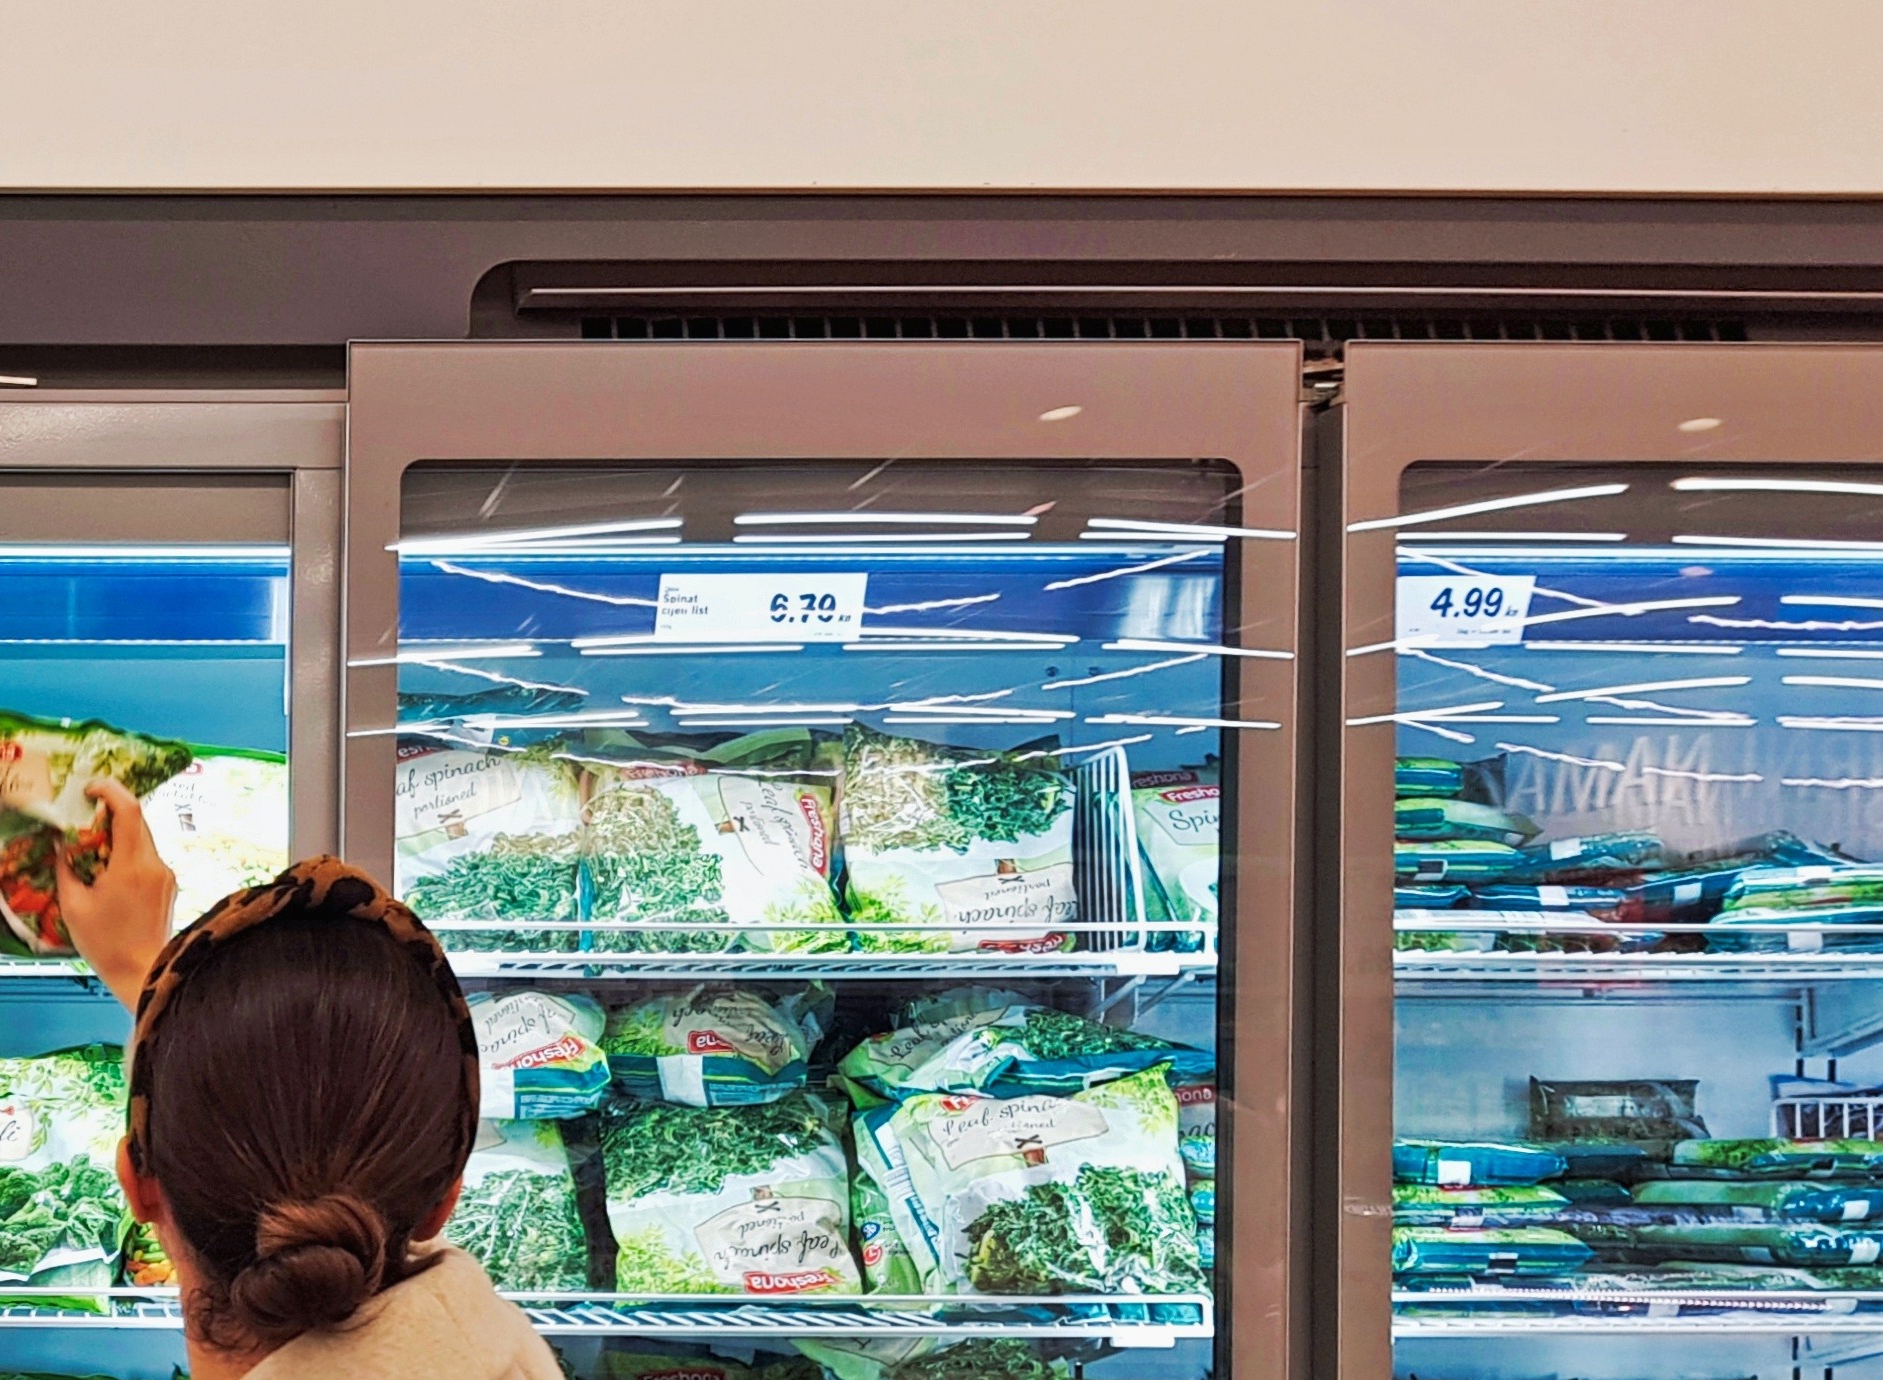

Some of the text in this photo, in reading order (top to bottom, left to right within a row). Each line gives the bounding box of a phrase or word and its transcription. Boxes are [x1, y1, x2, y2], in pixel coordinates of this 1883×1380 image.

[691, 605, 709, 615] list
[1430, 587, 1503, 617] 4.99
[424, 752, 501, 790] spinach
[414, 781, 478, 819] portioned
[801, 797, 823, 869] Freshona
